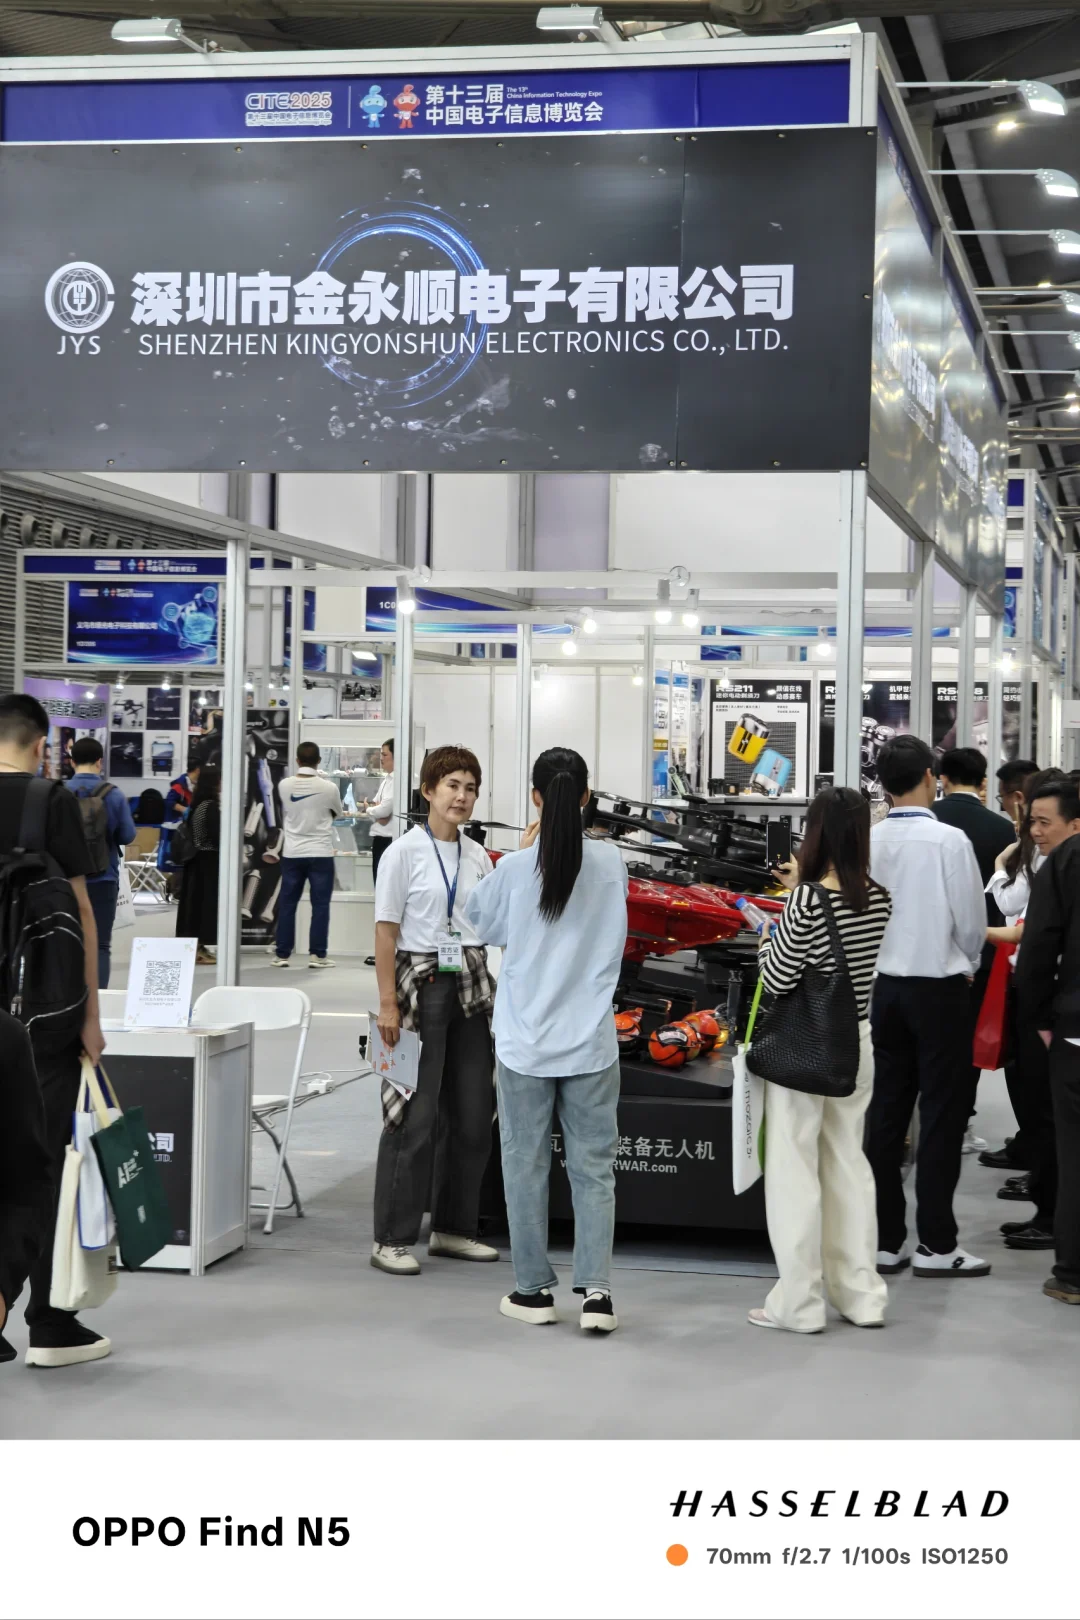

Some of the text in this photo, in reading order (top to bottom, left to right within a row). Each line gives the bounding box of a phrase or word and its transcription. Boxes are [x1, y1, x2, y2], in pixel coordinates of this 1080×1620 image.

[245, 91, 332, 109] CITE2025
[425, 84, 504, 105] 第十三届
[588, 90, 603, 98] Expo
[425, 101, 604, 126] 中国电子信息博览会
[131, 264, 794, 327] 深圳市金永顺电子有限公司
[56, 335, 101, 355] JYS
[138, 328, 789, 356] SHENZHEN KINGYONSHUN ELECTRONICS CO., LTD.
